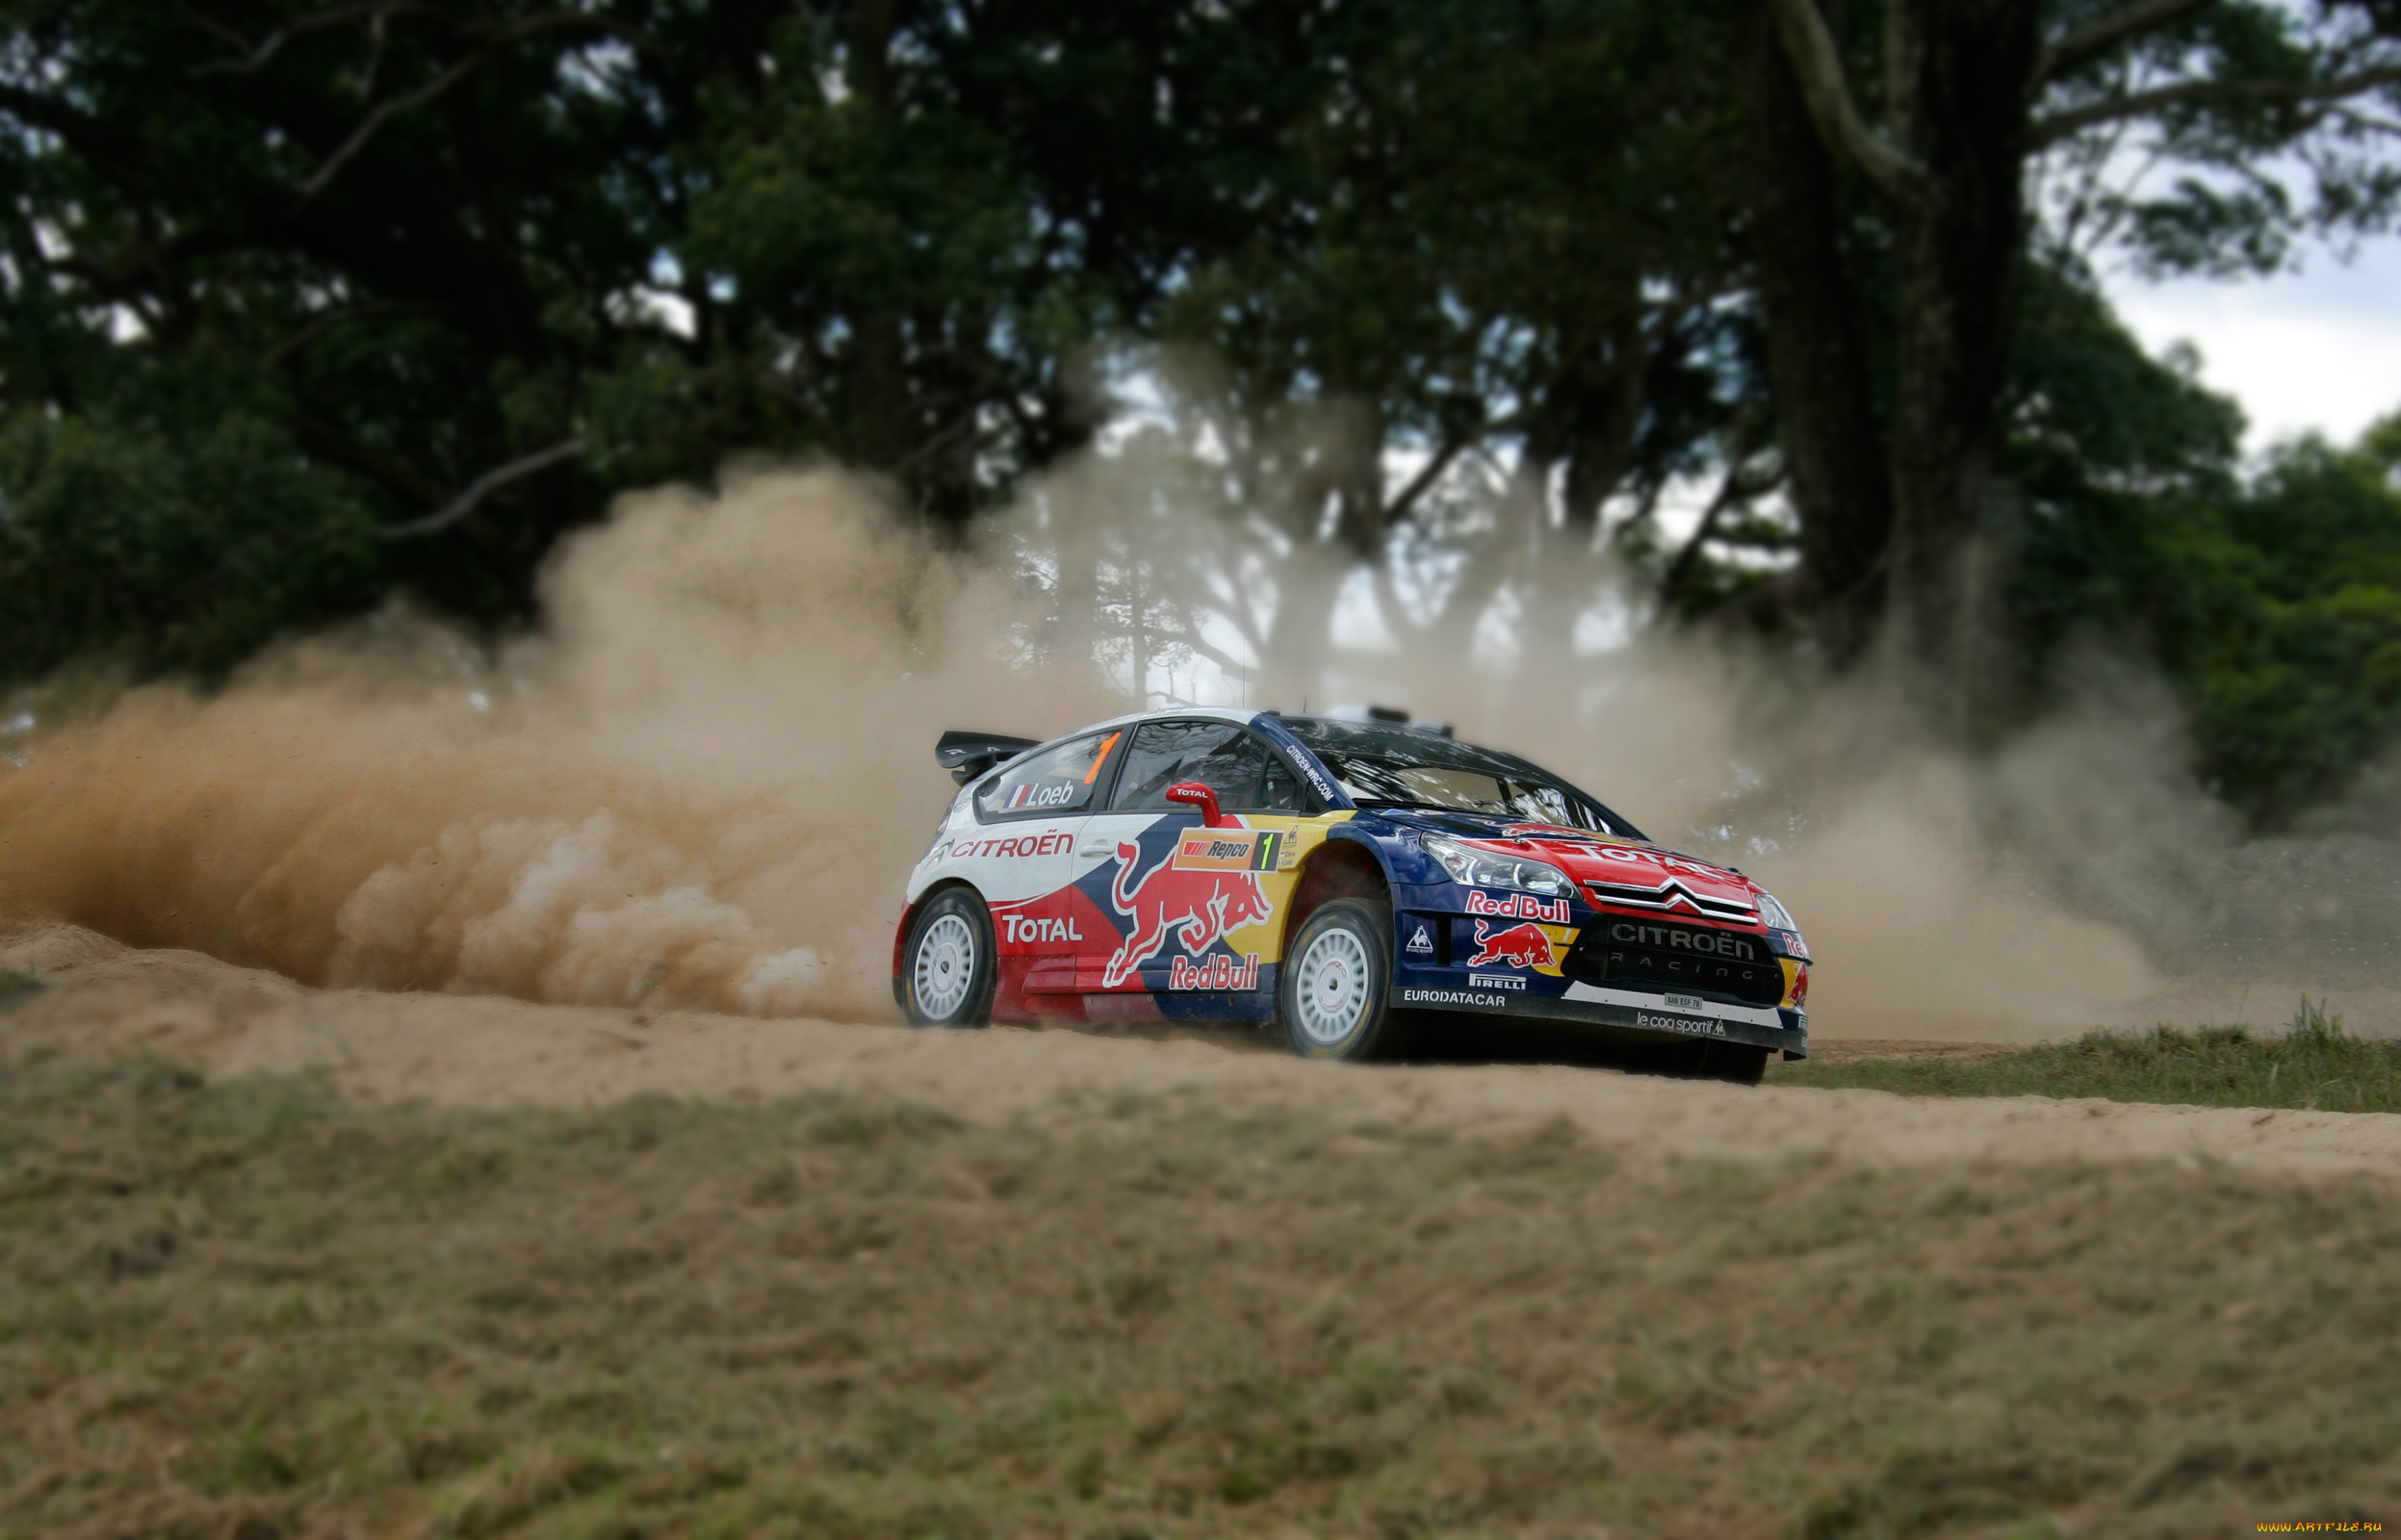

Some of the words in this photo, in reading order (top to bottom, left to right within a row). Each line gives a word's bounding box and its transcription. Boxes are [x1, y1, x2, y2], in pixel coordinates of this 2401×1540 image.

[1084, 732, 1122, 783] 1
[1286, 745, 1334, 802] CITROEN-WRC.COM
[1025, 780, 1074, 807] Loeb
[1176, 788, 1209, 799] TOTAL
[1207, 840, 1250, 860] Repco
[1261, 833, 1274, 870] 1
[1465, 890, 1519, 917] Red
[1519, 896, 1570, 924] Bull
[1002, 914, 1083, 943] TOTAL
[1169, 953, 1216, 989] Red
[1213, 952, 1258, 990] Bull
[1469, 973, 1527, 990] PIRELLI
[1404, 989, 1506, 1007] EURODATACAR
[1638, 1011, 1648, 1026] le
[1676, 1019, 1714, 1034] sportif
